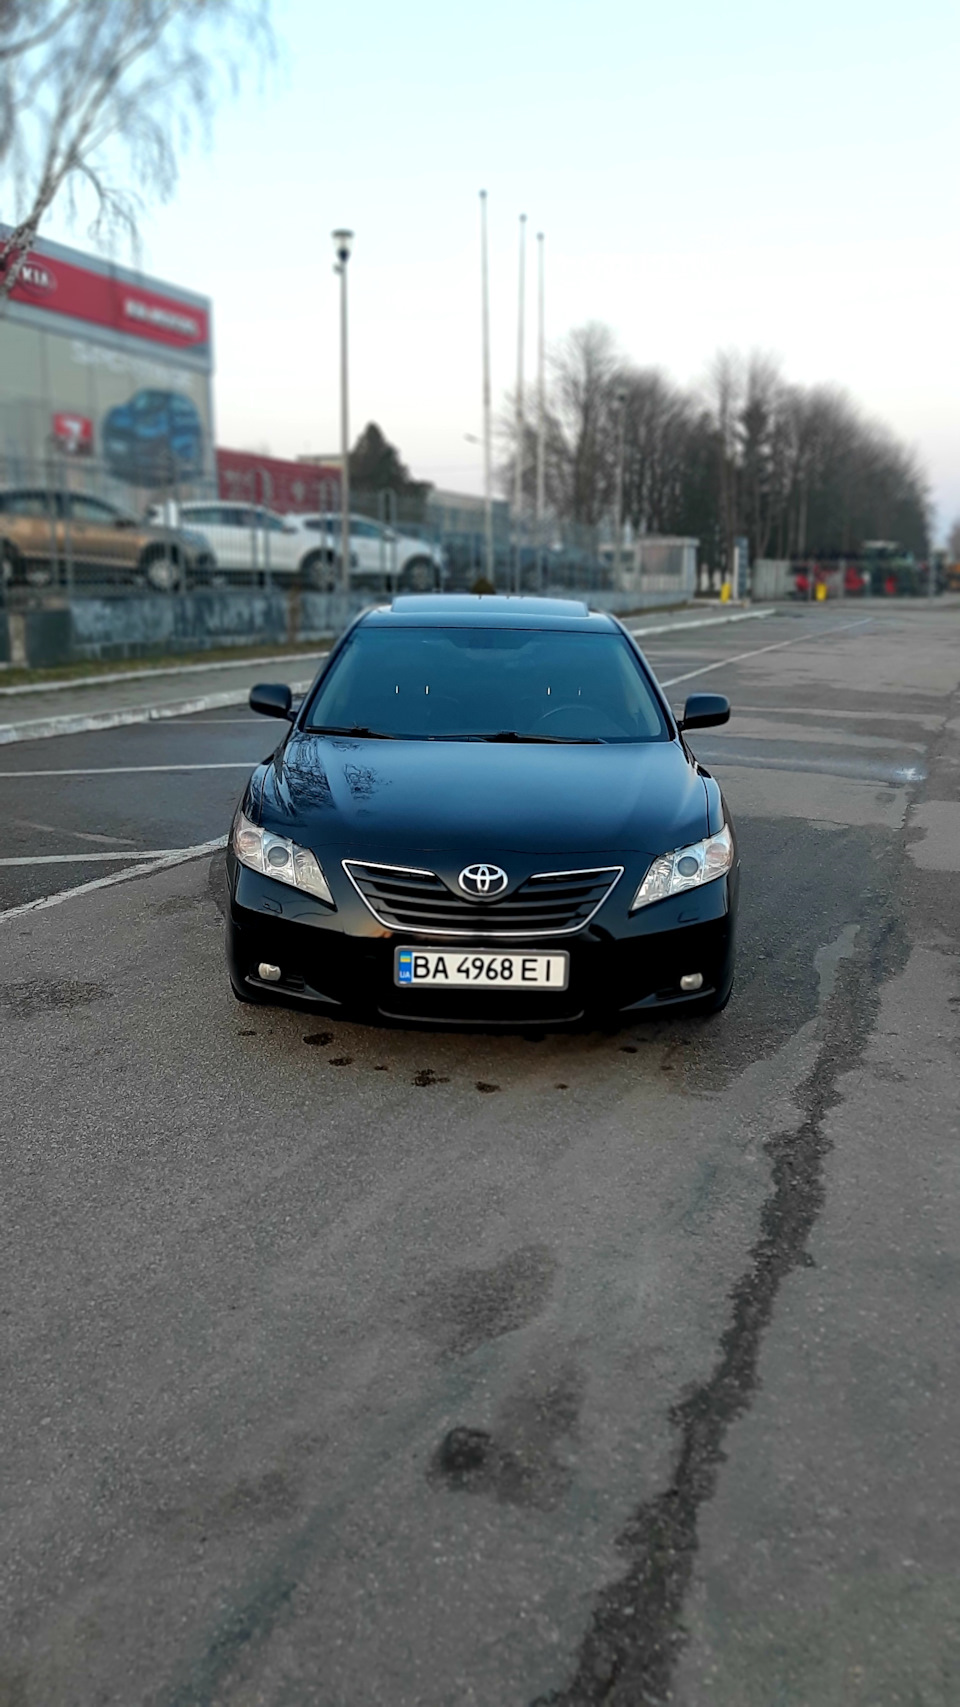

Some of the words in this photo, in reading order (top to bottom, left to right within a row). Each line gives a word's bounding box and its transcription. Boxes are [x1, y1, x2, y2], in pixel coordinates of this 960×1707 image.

[22, 265, 49, 288] KIA
[399, 970, 411, 979] UA
[413, 955, 449, 980] BA
[456, 957, 513, 981] 4968
[521, 958, 551, 982] EI
